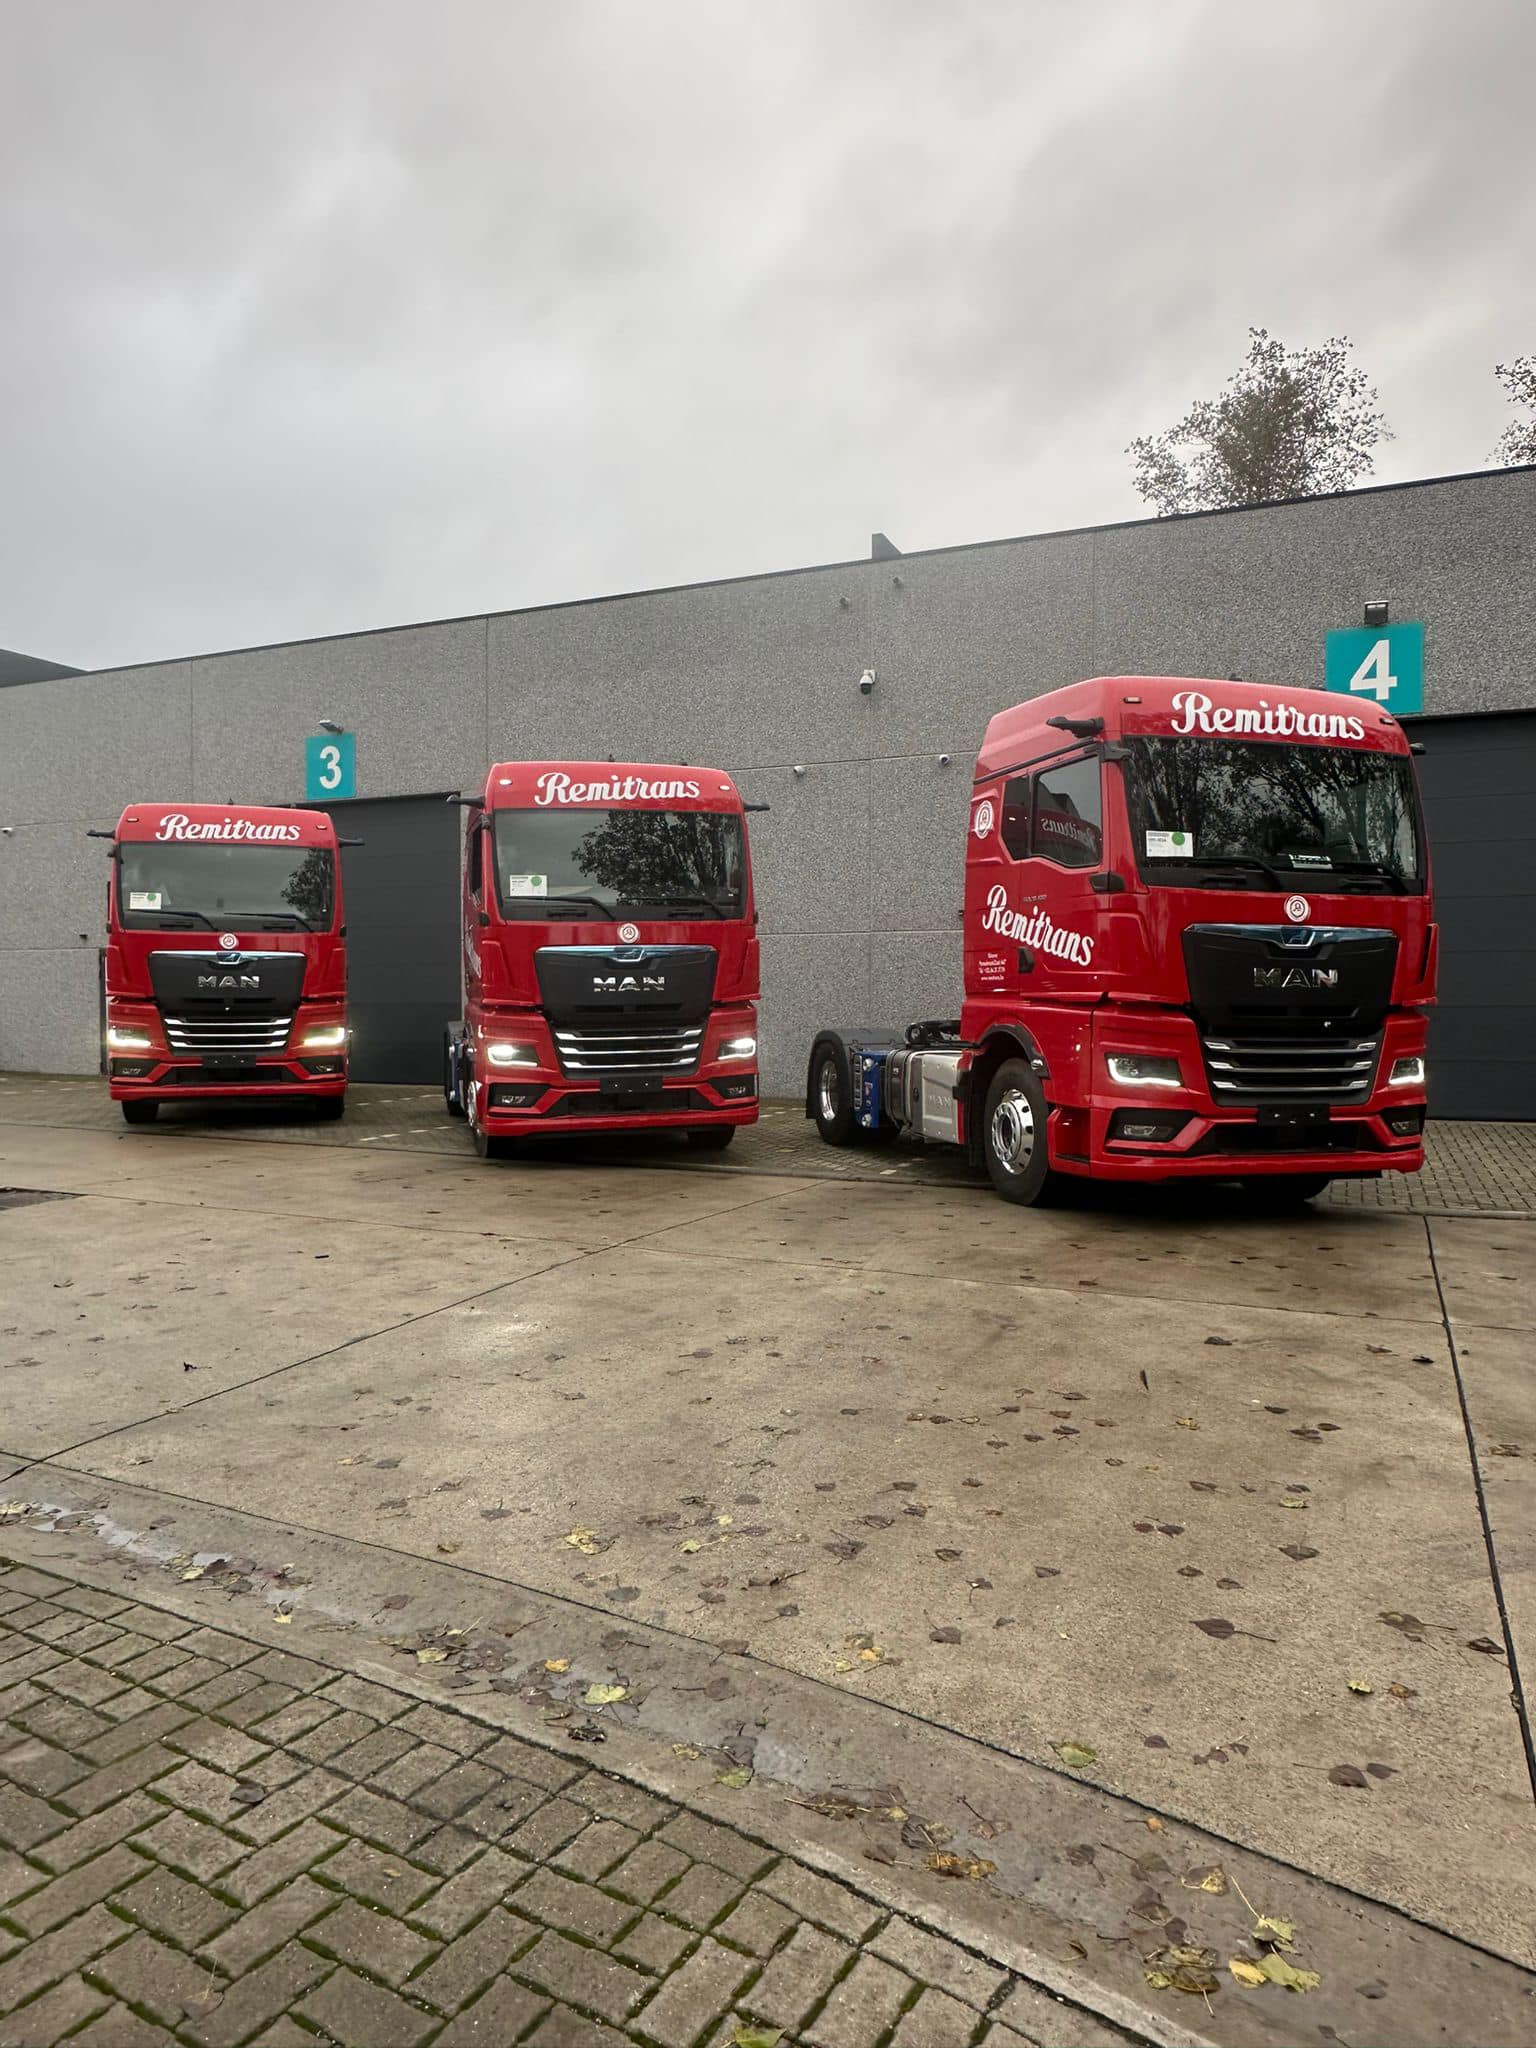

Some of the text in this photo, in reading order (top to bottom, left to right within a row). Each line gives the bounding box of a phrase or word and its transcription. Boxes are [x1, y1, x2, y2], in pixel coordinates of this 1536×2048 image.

[1349, 639, 1398, 700] 4
[1171, 691, 1366, 740] Remitrans
[319, 745, 342, 790] 3
[534, 772, 702, 806] Remitrans
[154, 813, 301, 842] Remitrans
[982, 884, 1095, 967] Remitrans
[197, 975, 260, 989] MAN
[593, 976, 665, 993] MAN
[1253, 967, 1338, 989] MAN
